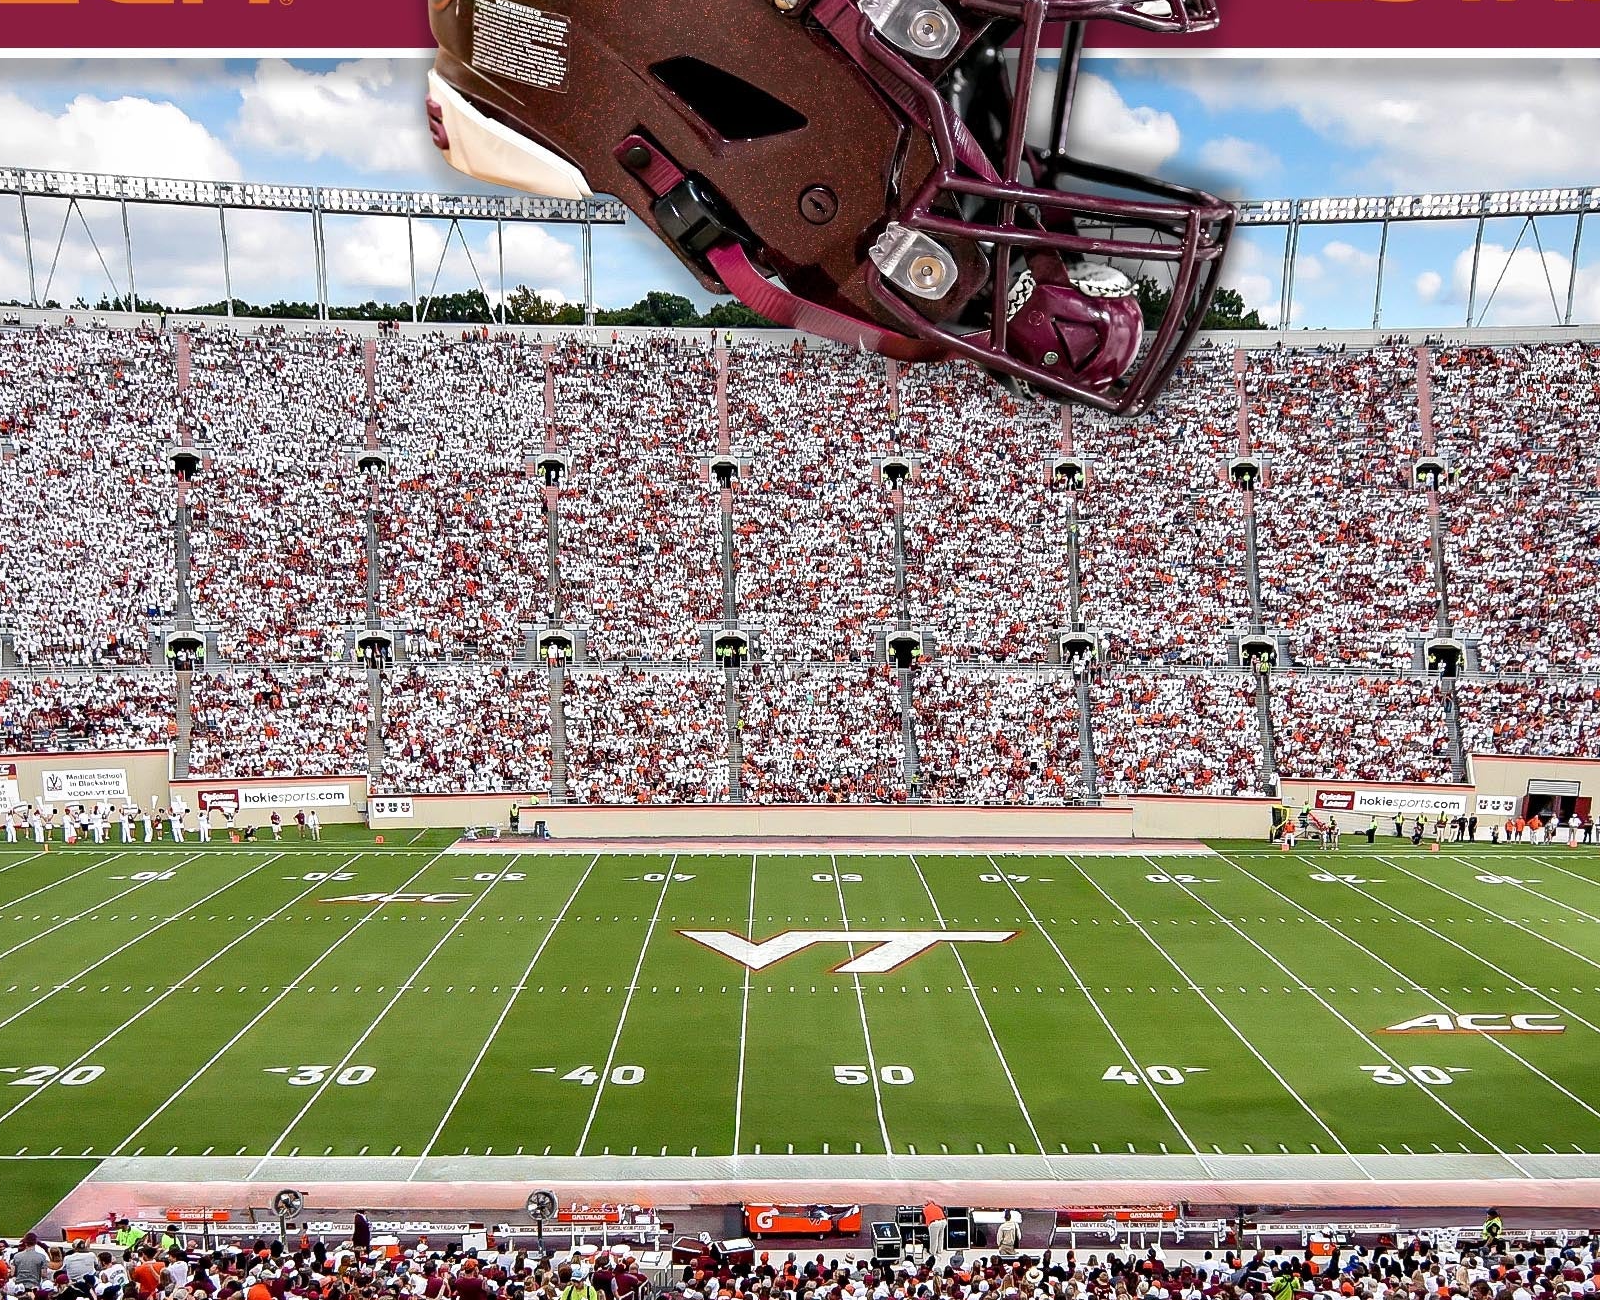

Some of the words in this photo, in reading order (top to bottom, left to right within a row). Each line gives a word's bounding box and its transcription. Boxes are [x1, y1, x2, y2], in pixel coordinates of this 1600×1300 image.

[244, 790, 345, 804] hokiesports.com
[1359, 795, 1461, 810] hokiesports.com
[674, 929, 1021, 974] VT
[1371, 1013, 1568, 1035] ACC
[7, 1065, 106, 1087] 20
[286, 1065, 378, 1087] 30
[558, 1065, 647, 1086] 40
[832, 1064, 916, 1086] 50
[1101, 1064, 1186, 1086] 40
[1358, 1064, 1454, 1086] 30
[756, 1211, 774, 1229] G
